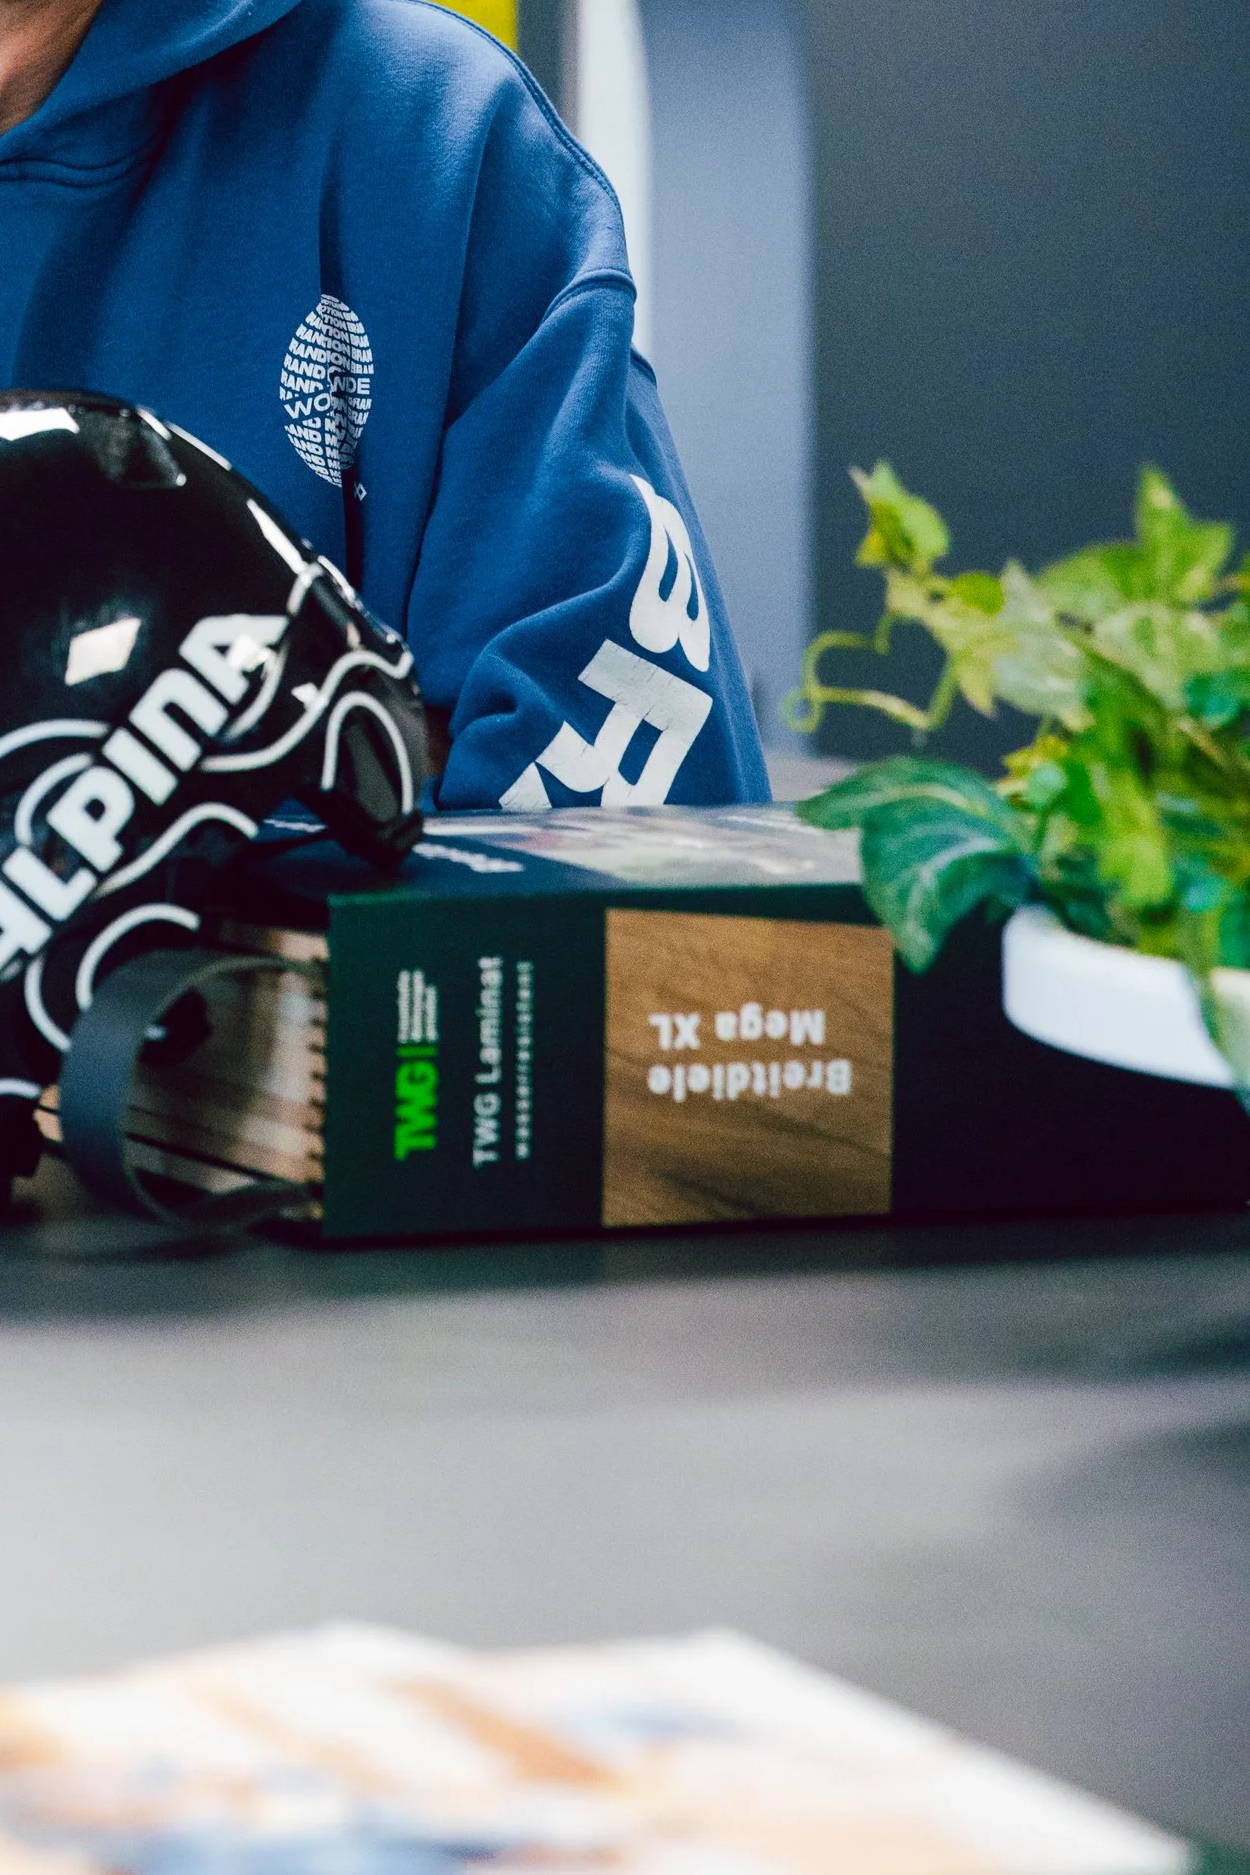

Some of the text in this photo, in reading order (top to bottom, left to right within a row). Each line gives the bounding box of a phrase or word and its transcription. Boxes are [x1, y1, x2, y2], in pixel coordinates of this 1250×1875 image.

[473, 955, 503, 1167] TWG Laminat
[649, 1002, 826, 1050] Mega XL
[394, 1060, 437, 1161] TWG
[648, 1059, 852, 1102] Breitdiele
